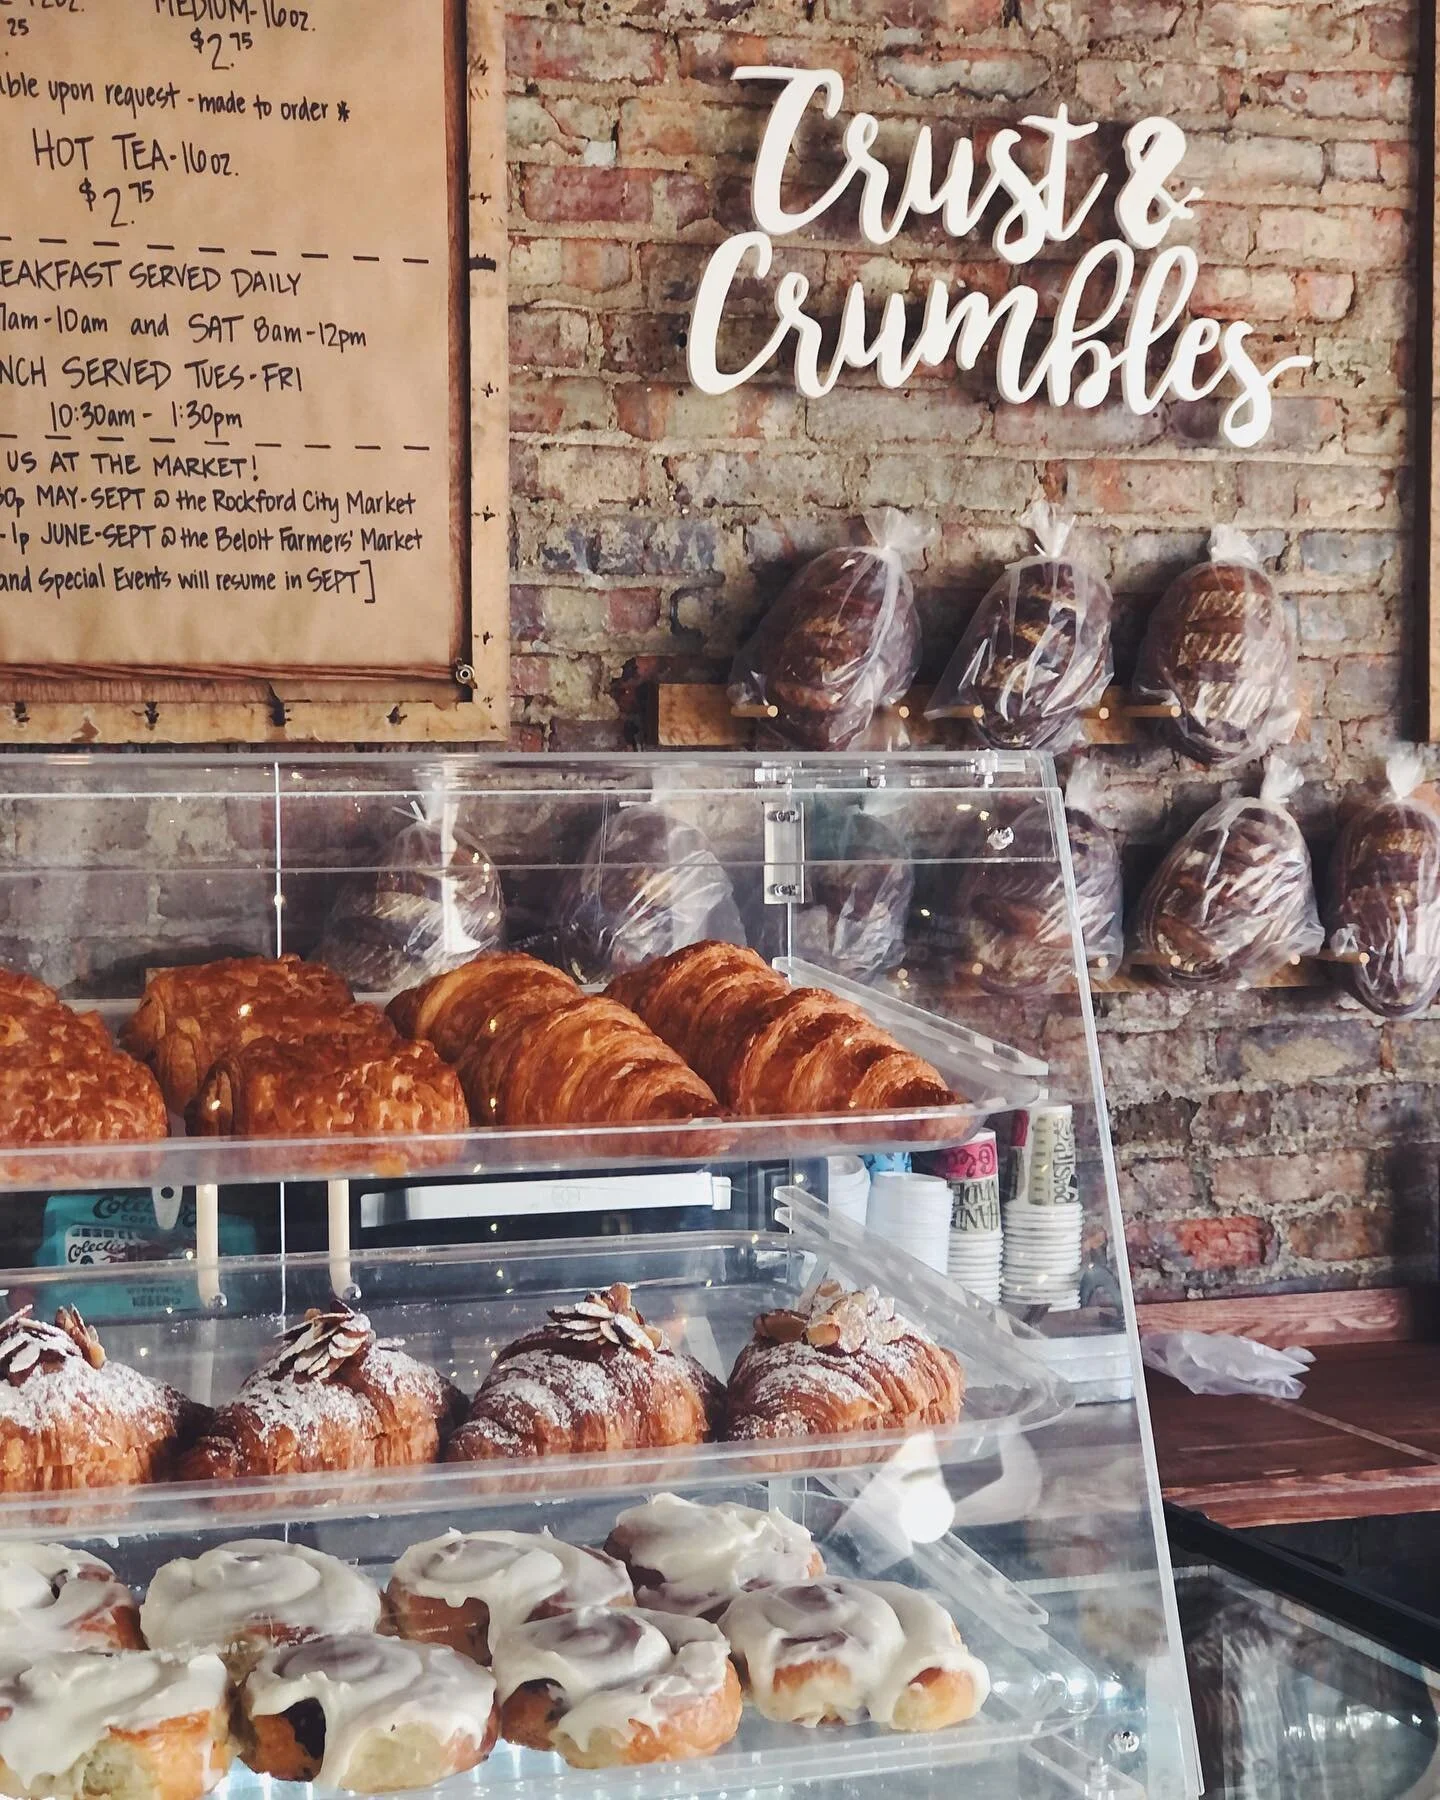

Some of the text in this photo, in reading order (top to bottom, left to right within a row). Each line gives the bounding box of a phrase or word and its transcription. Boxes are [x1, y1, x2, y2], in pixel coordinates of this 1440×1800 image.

[47, 79, 95, 116] upon
[104, 81, 181, 120] request
[252, 95, 273, 121] to
[280, 97, 329, 122] order
[31, 127, 95, 172] HOT
[731, 65, 1204, 264] Crust &
[128, 261, 222, 293] SERVED
[230, 267, 302, 299] DAILY
[130, 312, 170, 338] and
[188, 312, 245, 344] SAT
[253, 317, 367, 354] 8am-12pm
[688, 231, 1313, 448] Crumbles
[61, 355, 172, 391] SERVED
[183, 358, 303, 393] TUES-FRI
[171, 399, 243, 437] 1:30pm
[6, 449, 259, 483] US AT THE MARKET!
[36, 484, 146, 512] MAY-SEPT
[175, 489, 207, 513] the
[211, 487, 297, 514] Rockford
[302, 489, 340, 524] City
[345, 489, 417, 515] Market
[40, 521, 157, 549] JUNE-SEPT
[179, 526, 209, 550] the
[278, 525, 354, 554] Farmers'
[360, 527, 424, 552] Market
[38, 562, 106, 600] Special
[113, 565, 172, 592] Events
[177, 568, 210, 590] will
[215, 572, 277, 592] resume
[284, 570, 303, 591] in
